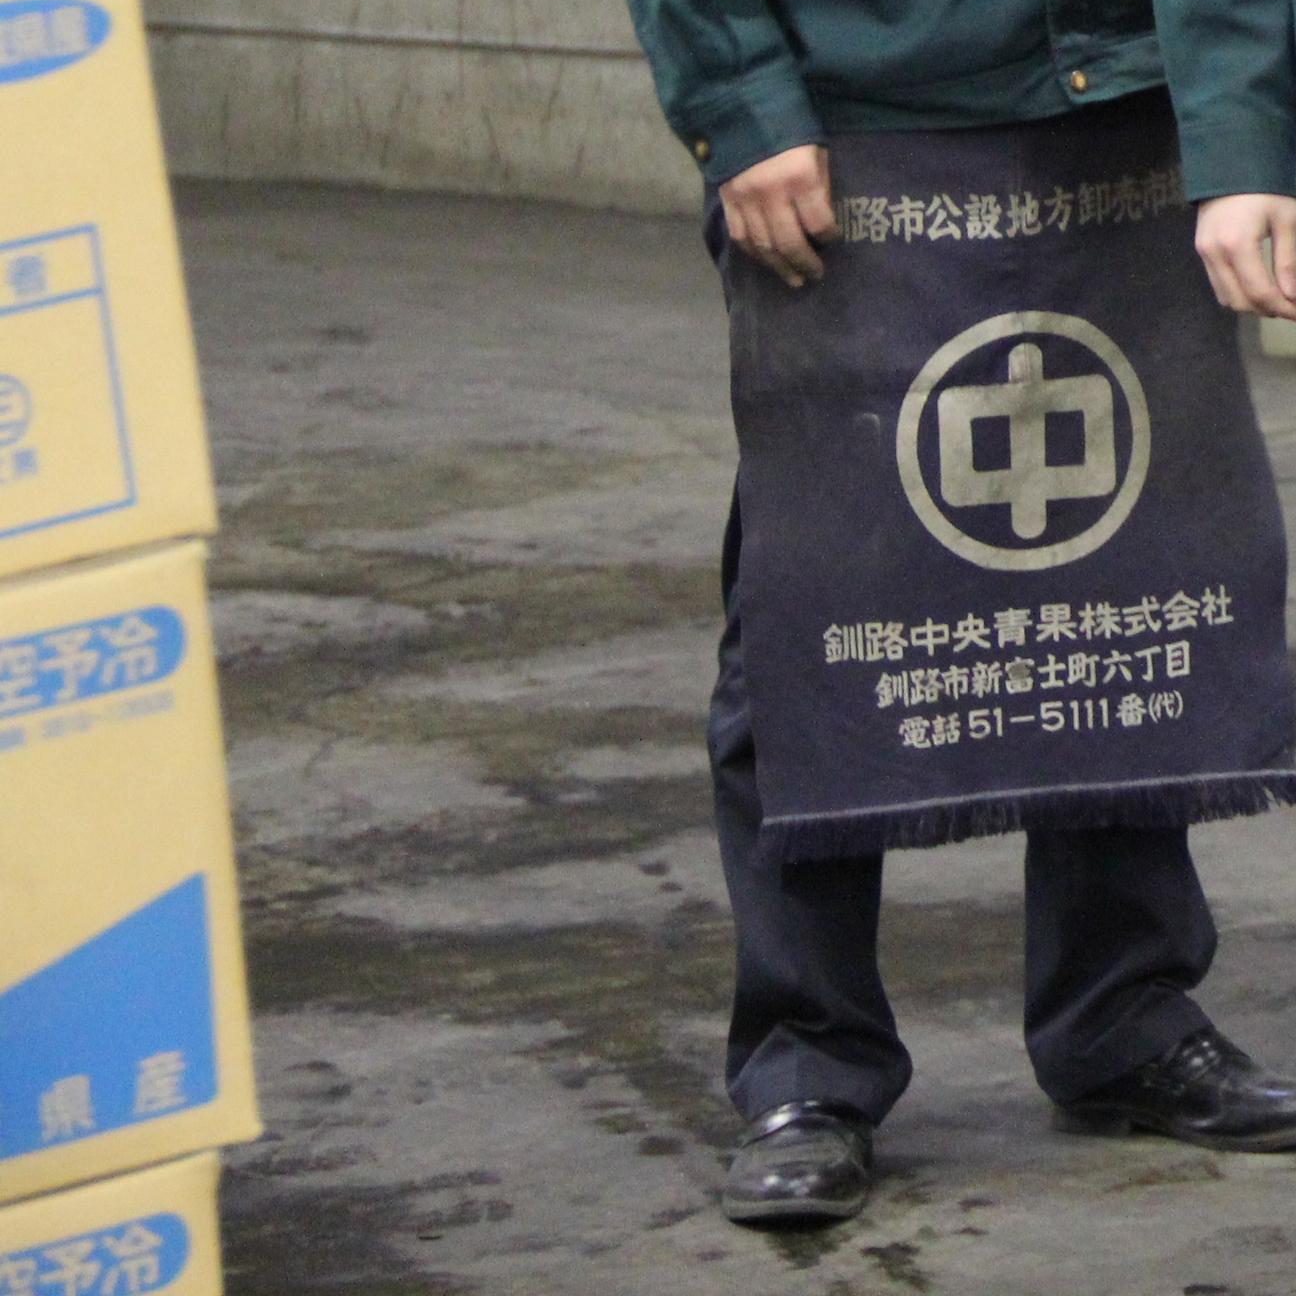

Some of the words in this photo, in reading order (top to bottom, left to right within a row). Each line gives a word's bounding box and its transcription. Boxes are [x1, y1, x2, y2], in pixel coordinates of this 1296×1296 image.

[937, 342, 1116, 539] 中
[822, 585, 1234, 664] 釧路中央青果株式会社
[875, 640, 1190, 709] 釧路市新富士町六丁目
